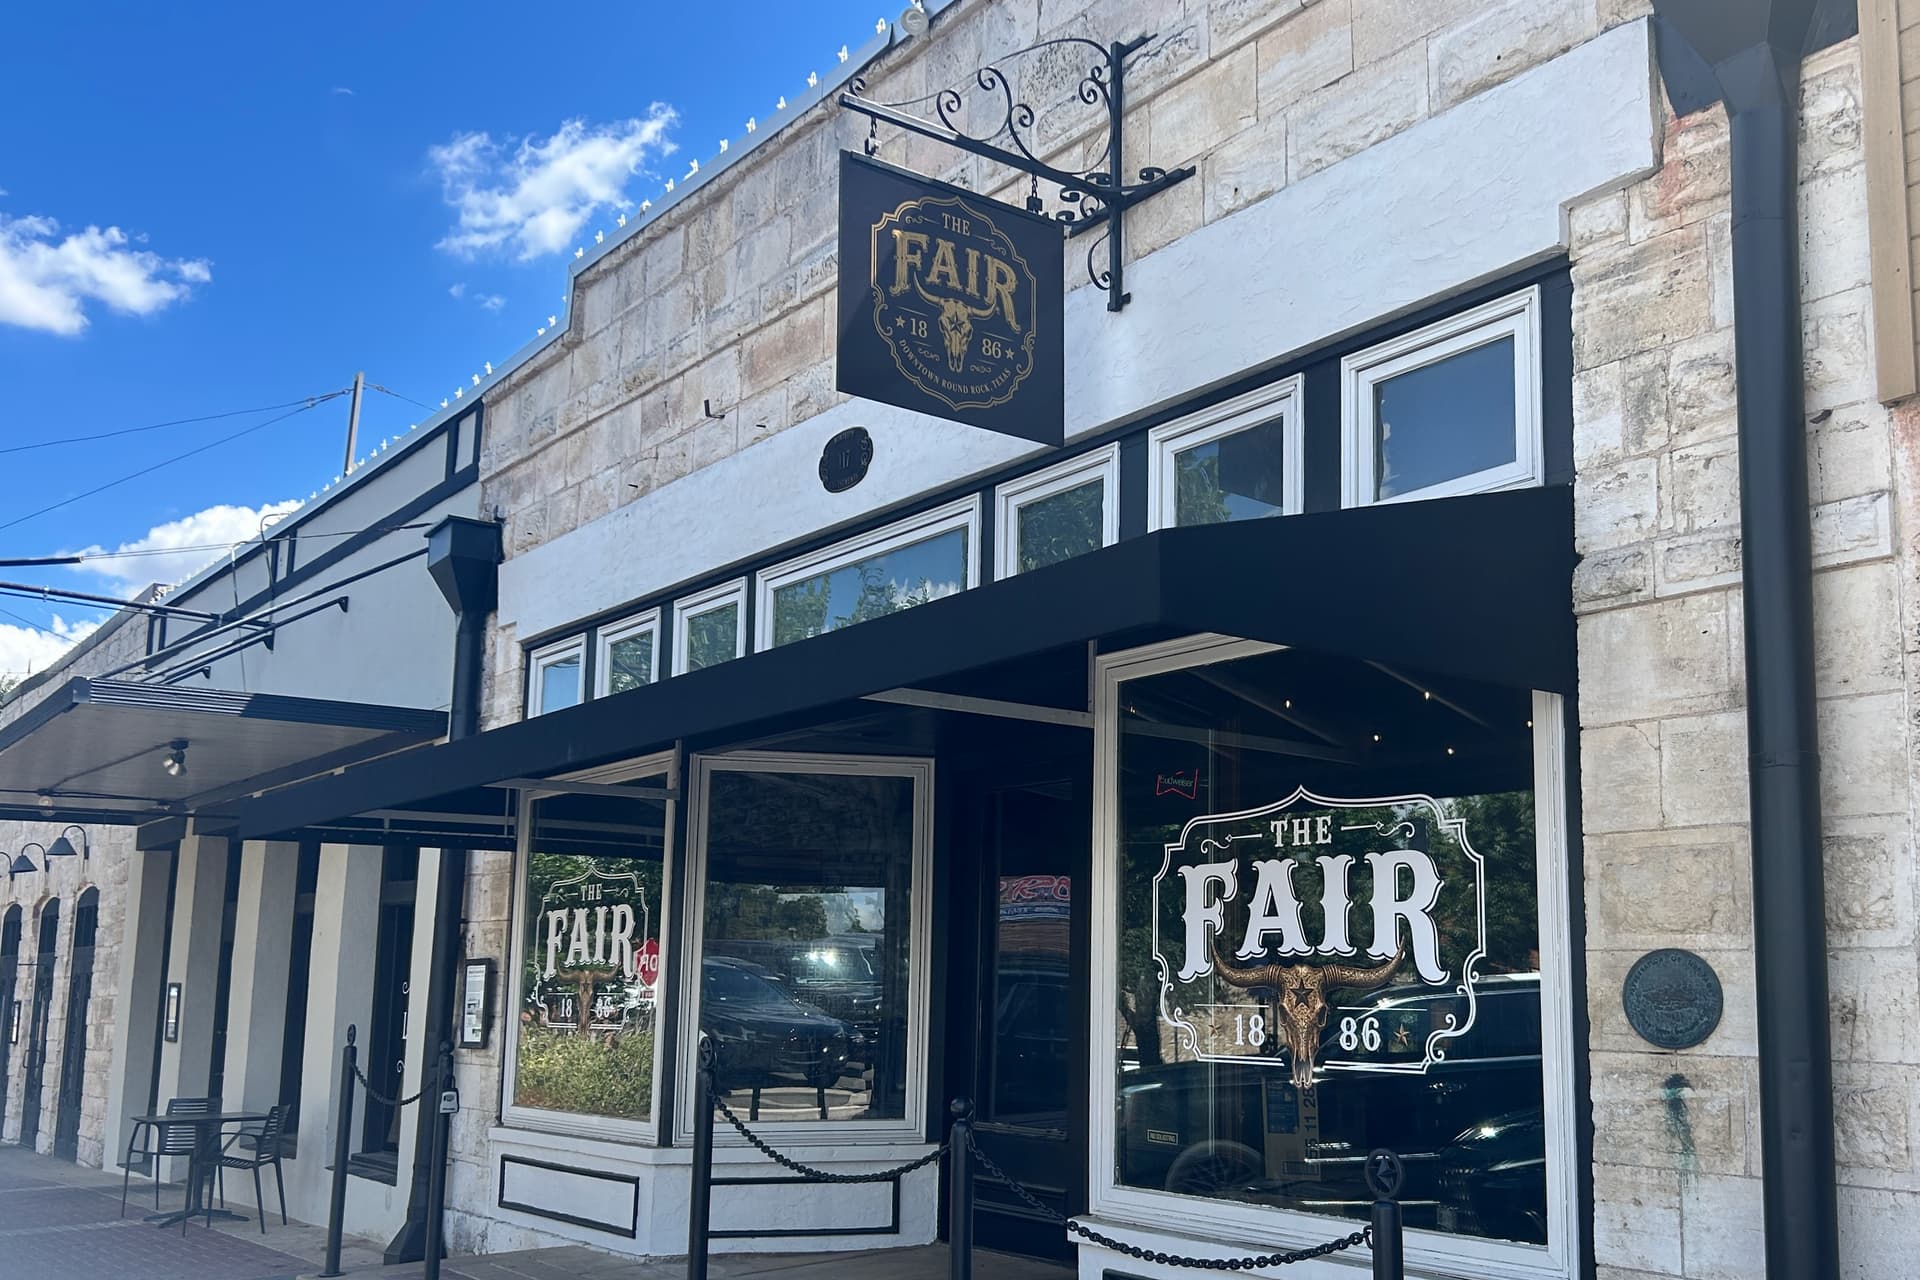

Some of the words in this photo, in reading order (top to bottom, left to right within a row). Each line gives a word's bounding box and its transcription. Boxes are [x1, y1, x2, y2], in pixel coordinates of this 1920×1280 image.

[942, 212, 971, 237] THE
[889, 229, 1021, 334] FAIR
[910, 318, 928, 337] 18
[982, 338, 1001, 358] 86
[899, 340, 940, 385] DOWNTOWN
[941, 379, 969, 393] ROUND
[992, 368, 1012, 389] TEXAS
[1271, 815, 1332, 848] THE
[581, 883, 602, 901] THE
[1177, 850, 1450, 986] FAIR
[542, 903, 636, 982] FAIR
[559, 998, 573, 1018] 18
[1234, 1014, 1265, 1046] 18
[1339, 1016, 1381, 1051] 86
